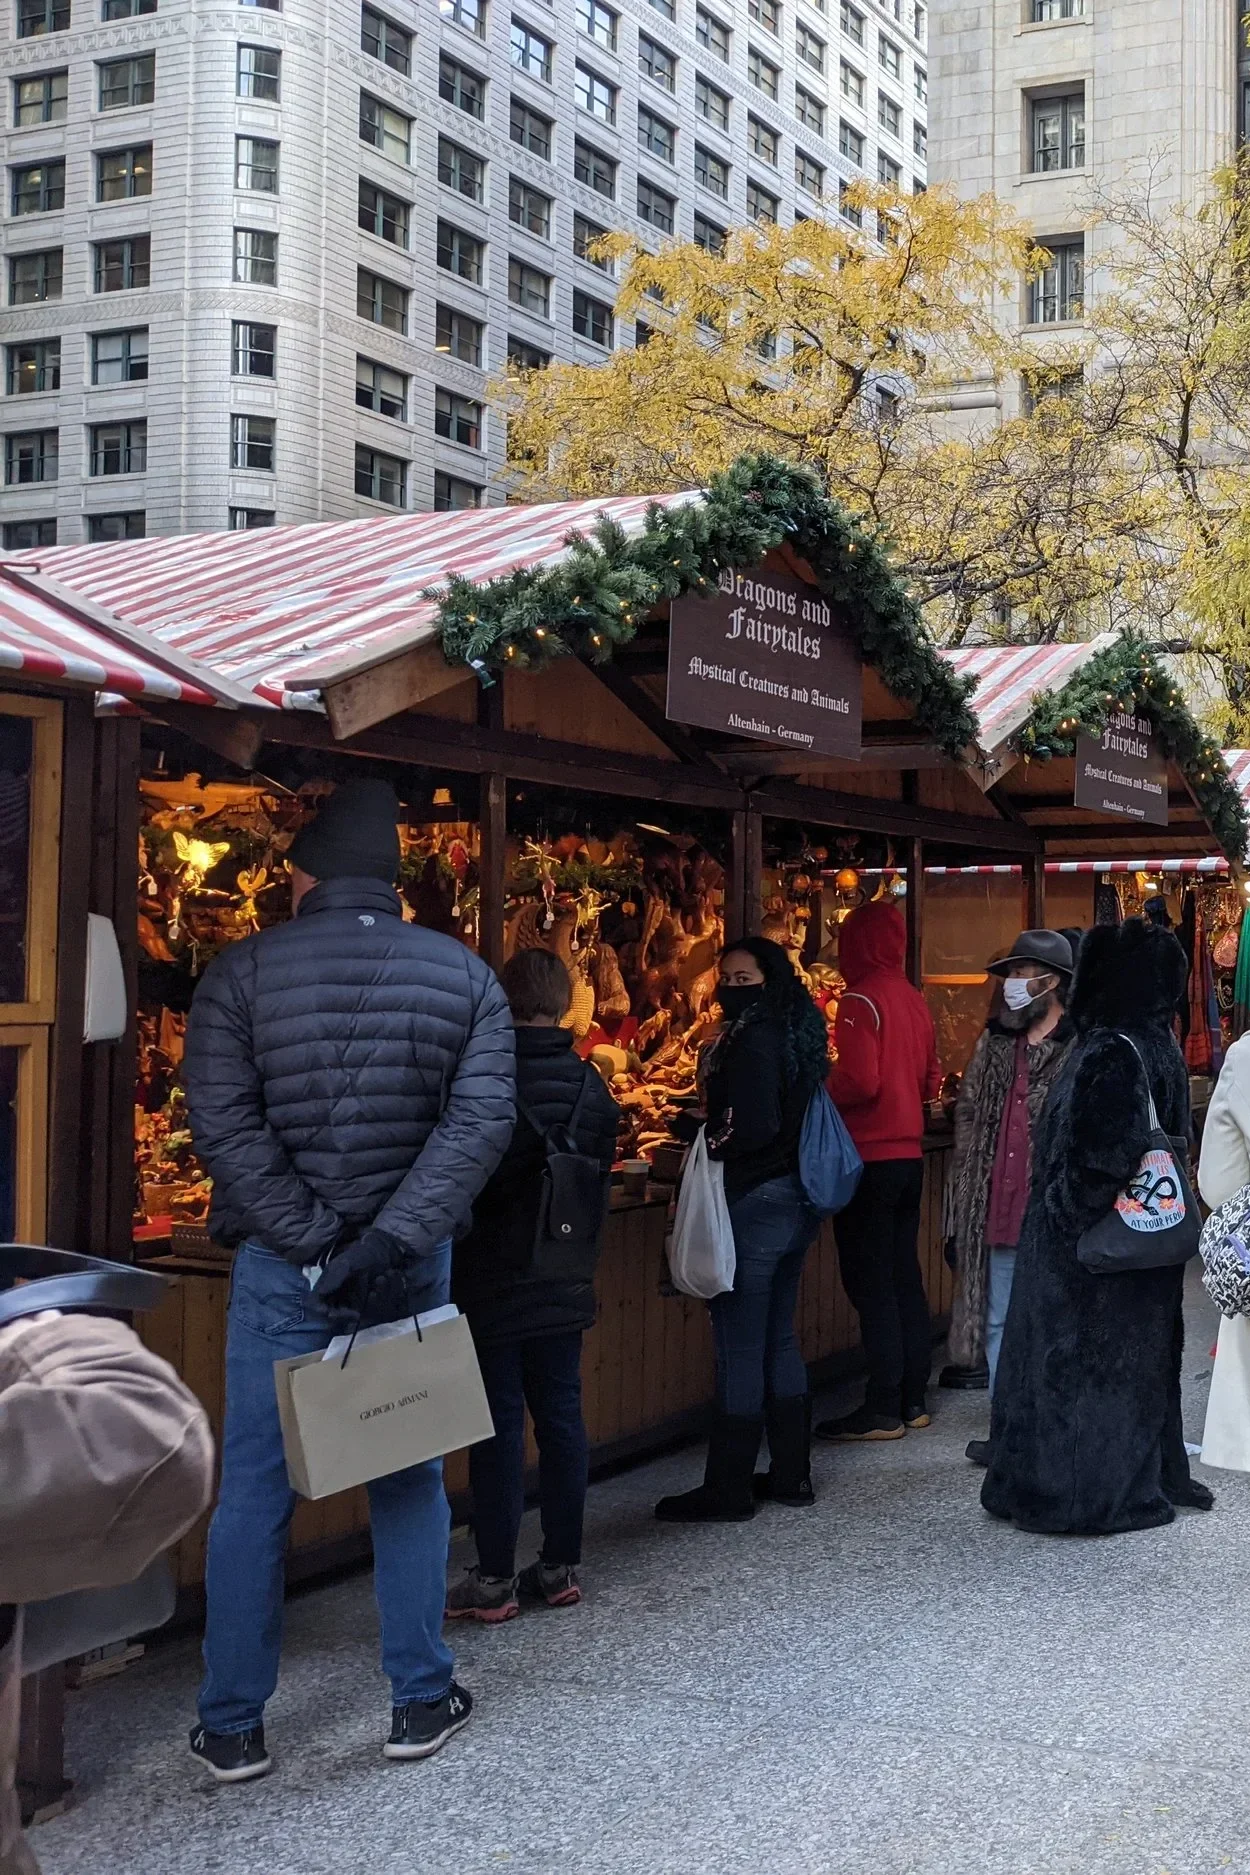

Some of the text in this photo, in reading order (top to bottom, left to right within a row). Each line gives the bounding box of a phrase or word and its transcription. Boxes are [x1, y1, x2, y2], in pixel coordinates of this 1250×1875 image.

[717, 566, 831, 627] Dragons and
[725, 606, 821, 659] Fairytales
[688, 656, 850, 714] Mystical Creatures and Animals
[728, 713, 770, 734] Altenhain
[777, 724, 815, 748] Germany
[1101, 728, 1148, 758] Fairytales
[1137, 718, 1152, 736] and
[1131, 1219, 1141, 1229] AT
[1142, 1217, 1164, 1229] YOUR
[360, 1402, 395, 1420] GIORGIO
